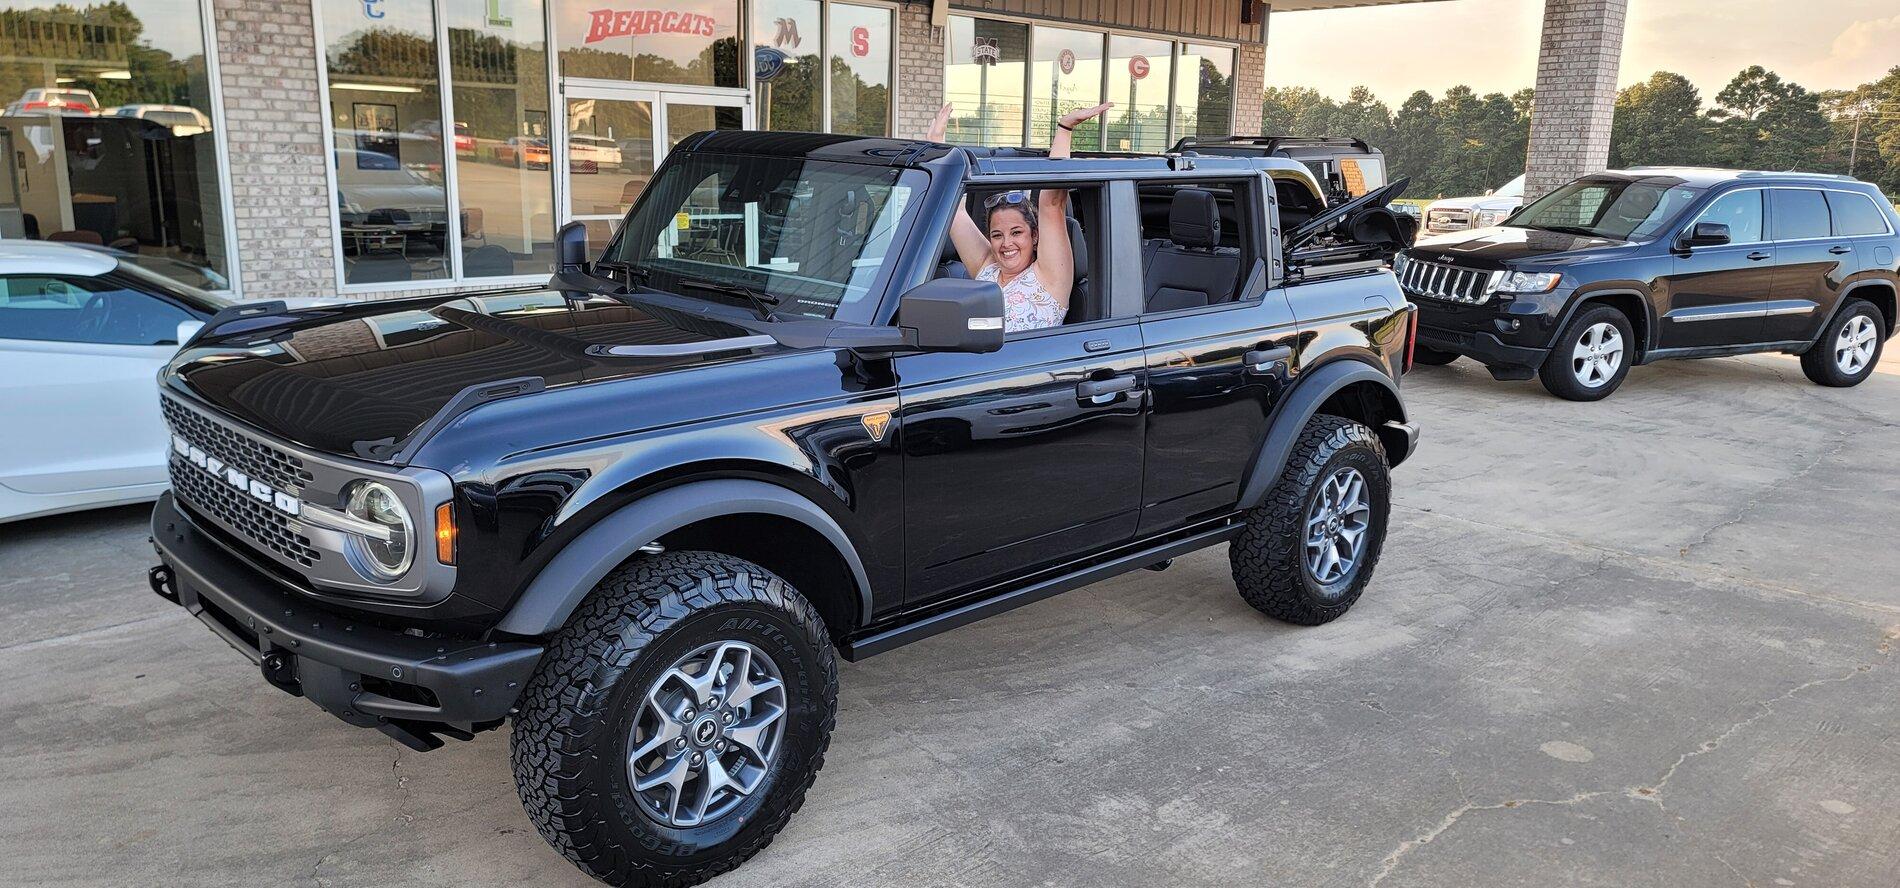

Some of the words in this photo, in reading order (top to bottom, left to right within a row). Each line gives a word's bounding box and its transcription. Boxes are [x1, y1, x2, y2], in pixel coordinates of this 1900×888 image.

[584, 9, 716, 44] BEARCATS
[852, 26, 870, 58] S
[976, 45, 997, 57] STATE
[1437, 254, 1455, 264] Jeep
[172, 434, 300, 516] BRONCO
